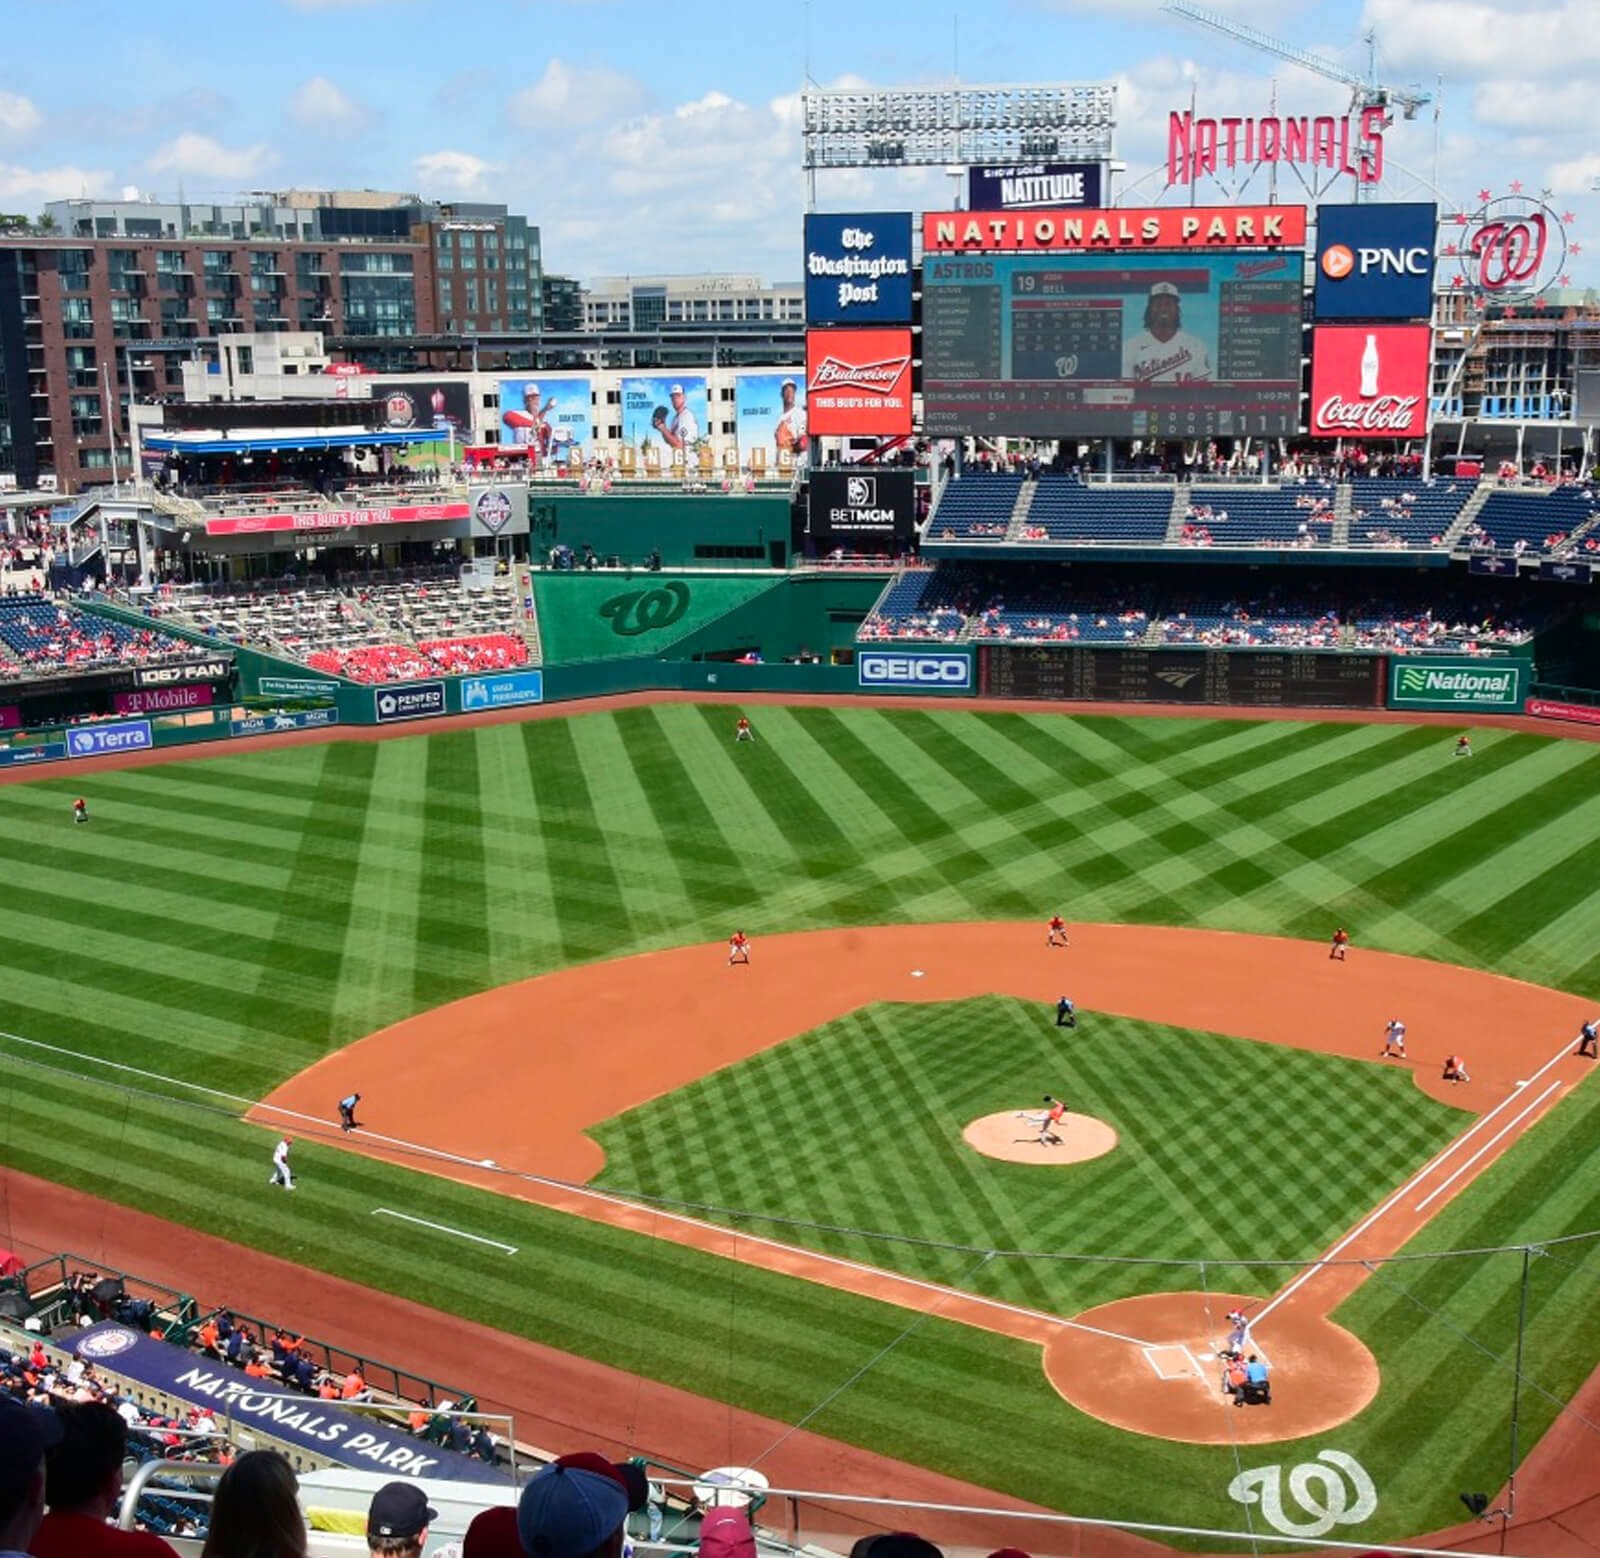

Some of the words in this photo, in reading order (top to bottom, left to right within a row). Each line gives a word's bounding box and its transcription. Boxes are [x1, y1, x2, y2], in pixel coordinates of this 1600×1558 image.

[1168, 106, 1385, 184] NATIONALS
[984, 167, 1015, 178] SHOW
[1001, 173, 1084, 203] NATITUDE
[936, 216, 1160, 243] NATIONALS
[1183, 214, 1284, 239] PARK
[841, 228, 874, 250] The
[808, 253, 908, 279] Washington
[934, 263, 993, 278] ASTROS
[1359, 248, 1428, 275] PNC
[1018, 276, 1035, 291] 19
[1043, 285, 1065, 293] BELL
[839, 283, 878, 307] Post
[817, 363, 899, 381] Budweiser
[391, 400, 406, 412] 15
[816, 398, 835, 408] THIS
[836, 398, 862, 408] BUD'S
[865, 398, 882, 408] FOR
[927, 412, 958, 420] ASTROS
[1317, 395, 1421, 430] Coca-Cola
[727, 448, 791, 466] BIG
[293, 513, 315, 529] THIS
[318, 511, 348, 527] BUD'S
[350, 510, 367, 526] FOR
[830, 508, 895, 522] BETMGM
[185, 663, 224, 679] FAN
[862, 658, 967, 681] GEICO
[1425, 671, 1510, 691] National
[145, 689, 198, 710] Mobile
[398, 691, 440, 705] PENFED
[1453, 691, 1471, 699] Car
[1473, 692, 1505, 701] Rental
[241, 719, 264, 729] MGM
[306, 711, 328, 721] MGM
[94, 730, 145, 748] Terra
[175, 1367, 348, 1442] NATIONALS
[342, 1432, 439, 1476] PARK
